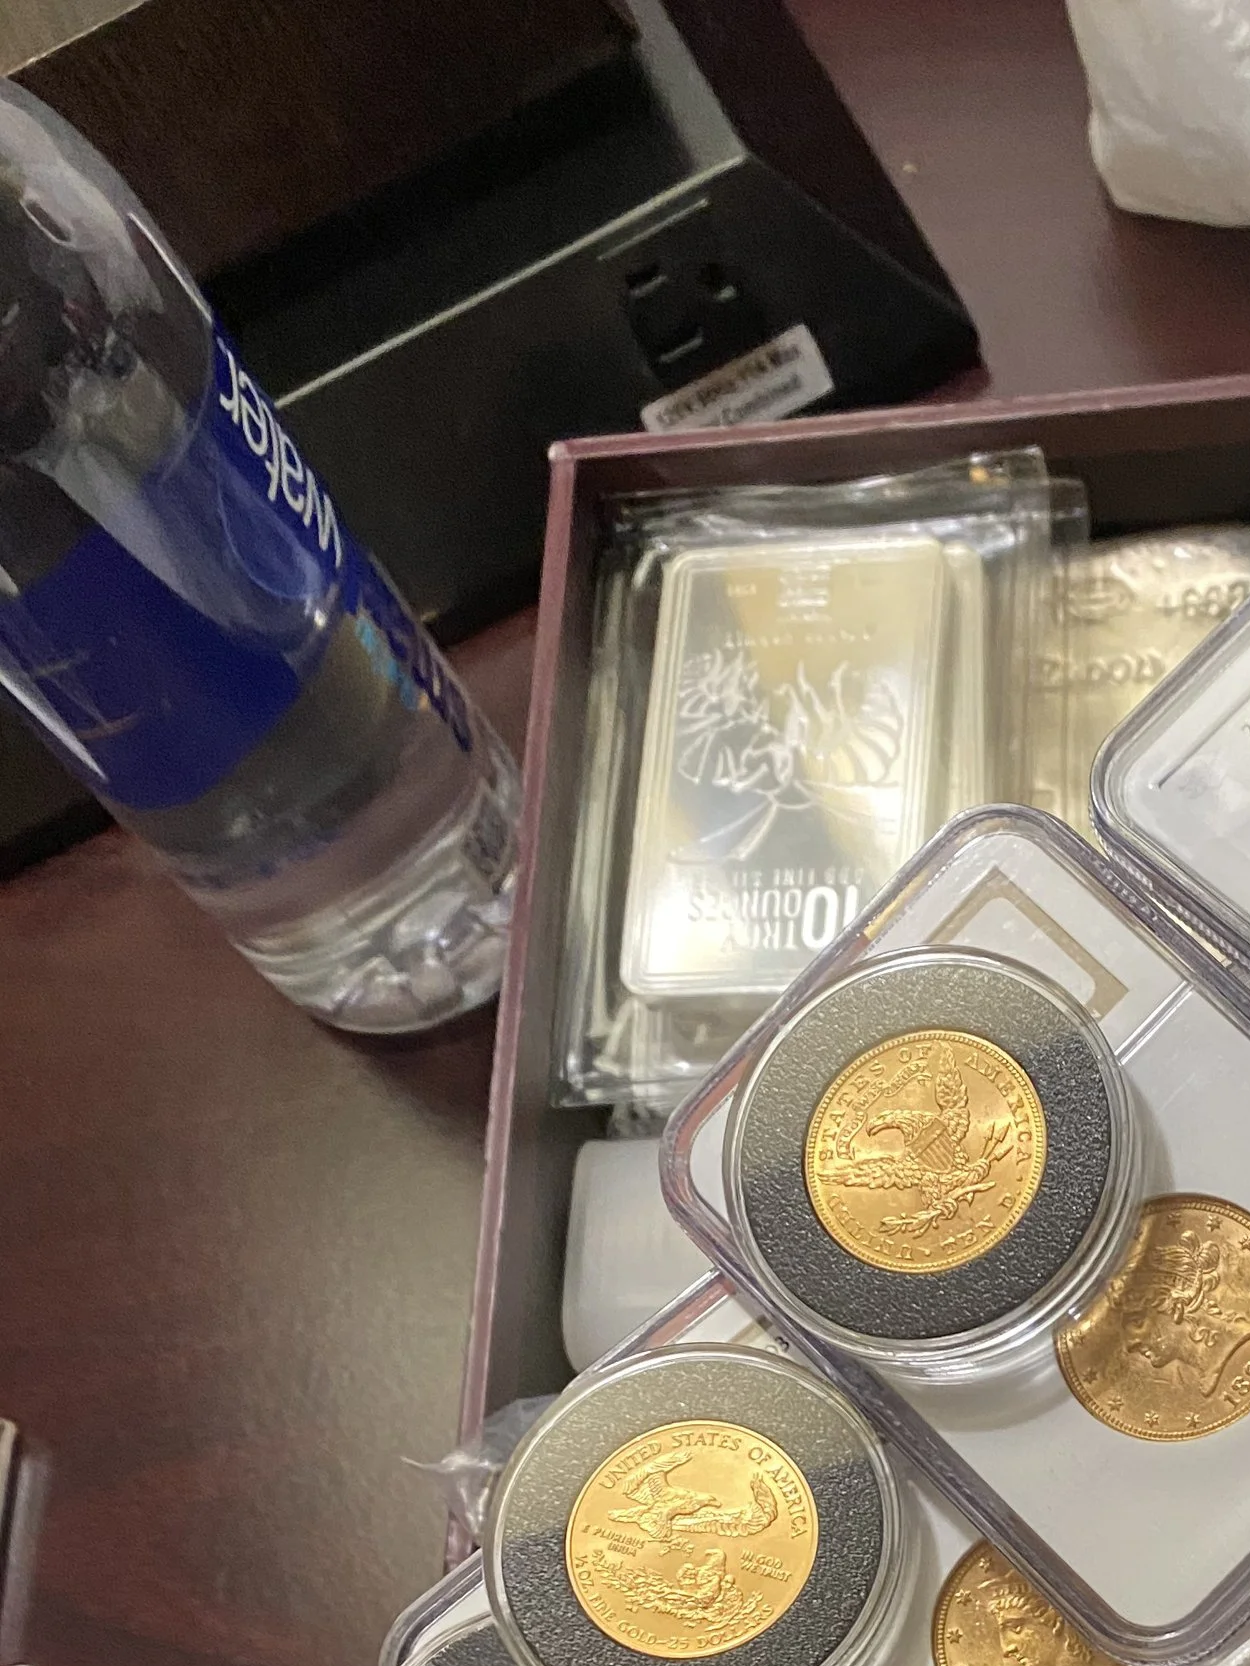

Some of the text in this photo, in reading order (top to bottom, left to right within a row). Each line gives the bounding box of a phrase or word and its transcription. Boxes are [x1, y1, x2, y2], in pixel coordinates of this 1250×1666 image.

[818, 1059, 886, 1162] STATES
[964, 1051, 1035, 1167] AMERICA
[940, 1214, 997, 1257] TEN
[598, 1431, 809, 1540] UNITED STATES OF AMERICA
[755, 1553, 784, 1570] GOD
[759, 1564, 792, 1583] TRUST
[589, 1593, 618, 1623] FINE
